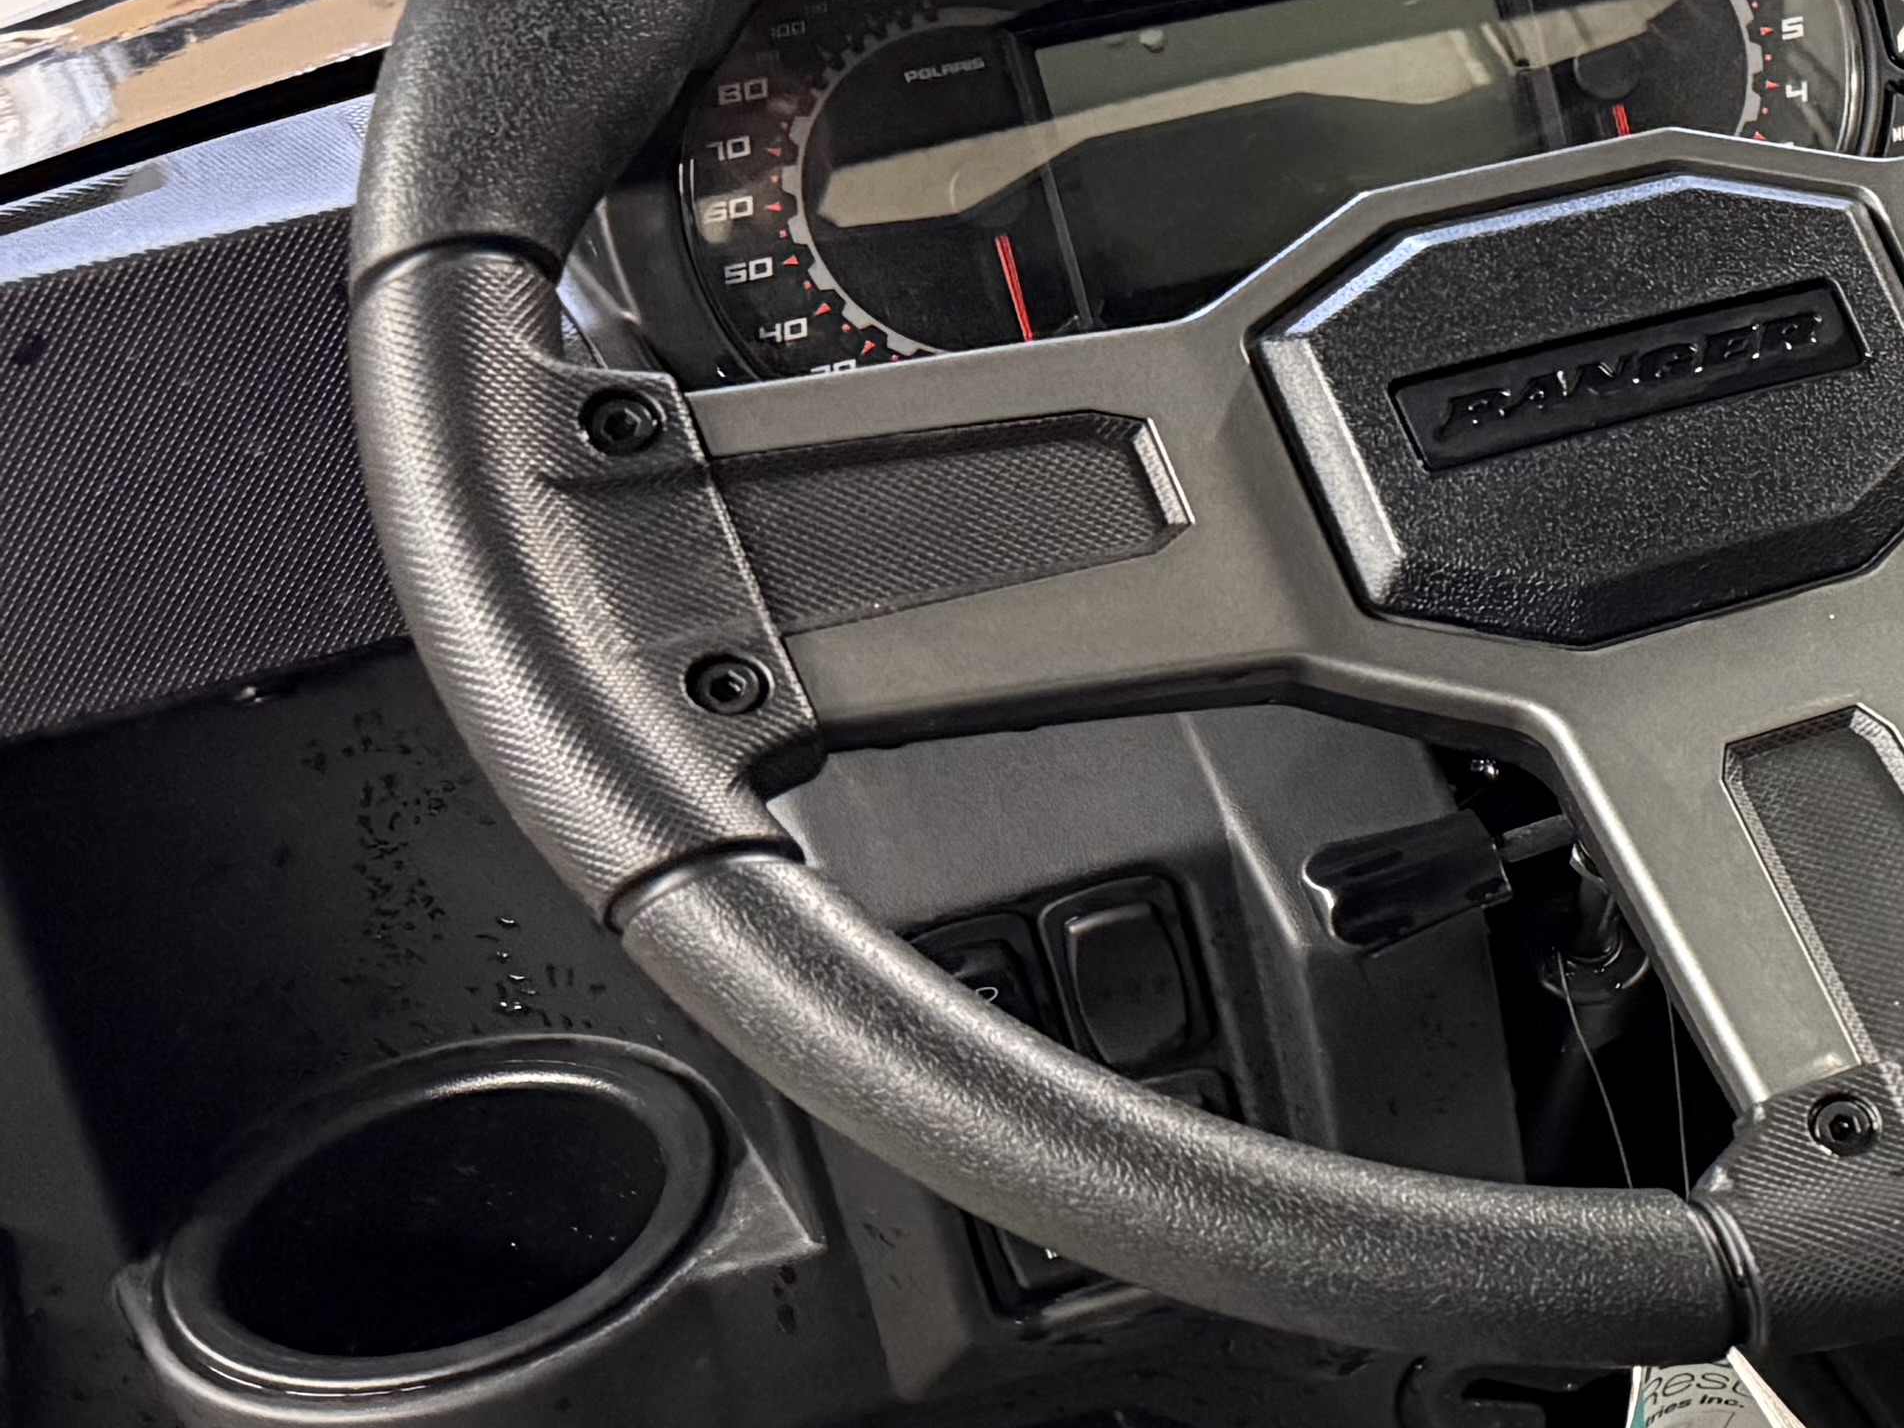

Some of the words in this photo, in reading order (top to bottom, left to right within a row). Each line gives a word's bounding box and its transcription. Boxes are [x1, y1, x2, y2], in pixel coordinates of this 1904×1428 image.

[1781, 16, 1804, 40] 5
[904, 57, 986, 83] POLARIS
[718, 77, 769, 106] 80
[1785, 81, 1808, 103] 4
[705, 135, 750, 161] 70
[703, 195, 754, 223] 60
[724, 257, 773, 285] 50
[758, 317, 808, 343] 40
[1433, 311, 1824, 442] RANGER
[1700, 1393, 1745, 1409] Inc.
